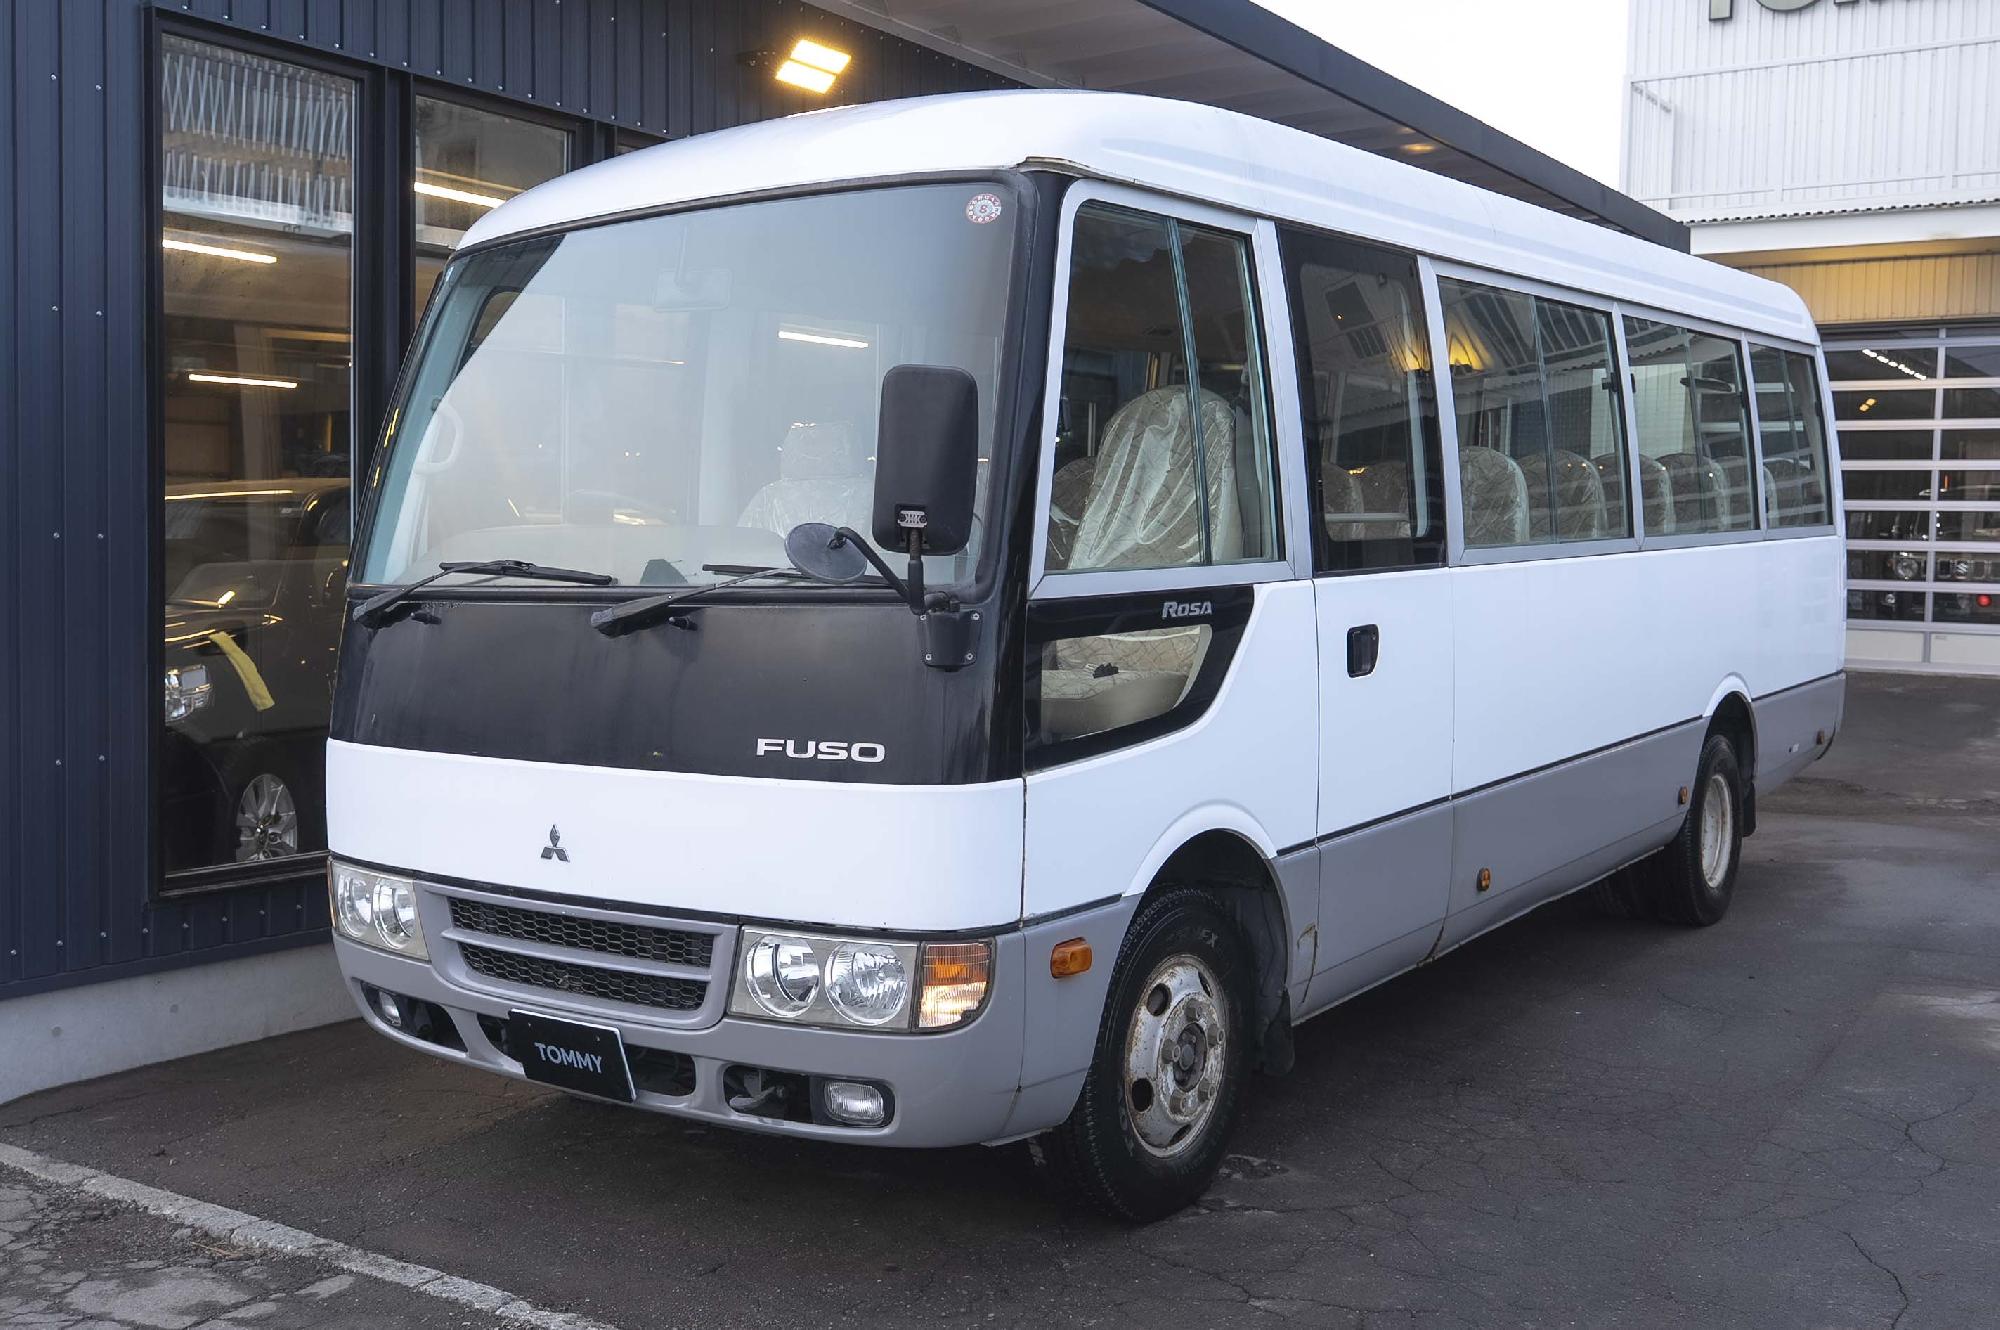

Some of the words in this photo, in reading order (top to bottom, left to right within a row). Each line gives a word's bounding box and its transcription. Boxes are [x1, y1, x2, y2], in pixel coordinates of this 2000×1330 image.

[1161, 601, 1213, 619] ROSA
[756, 738, 886, 763] FUSO
[533, 1041, 603, 1075] TOMMY
